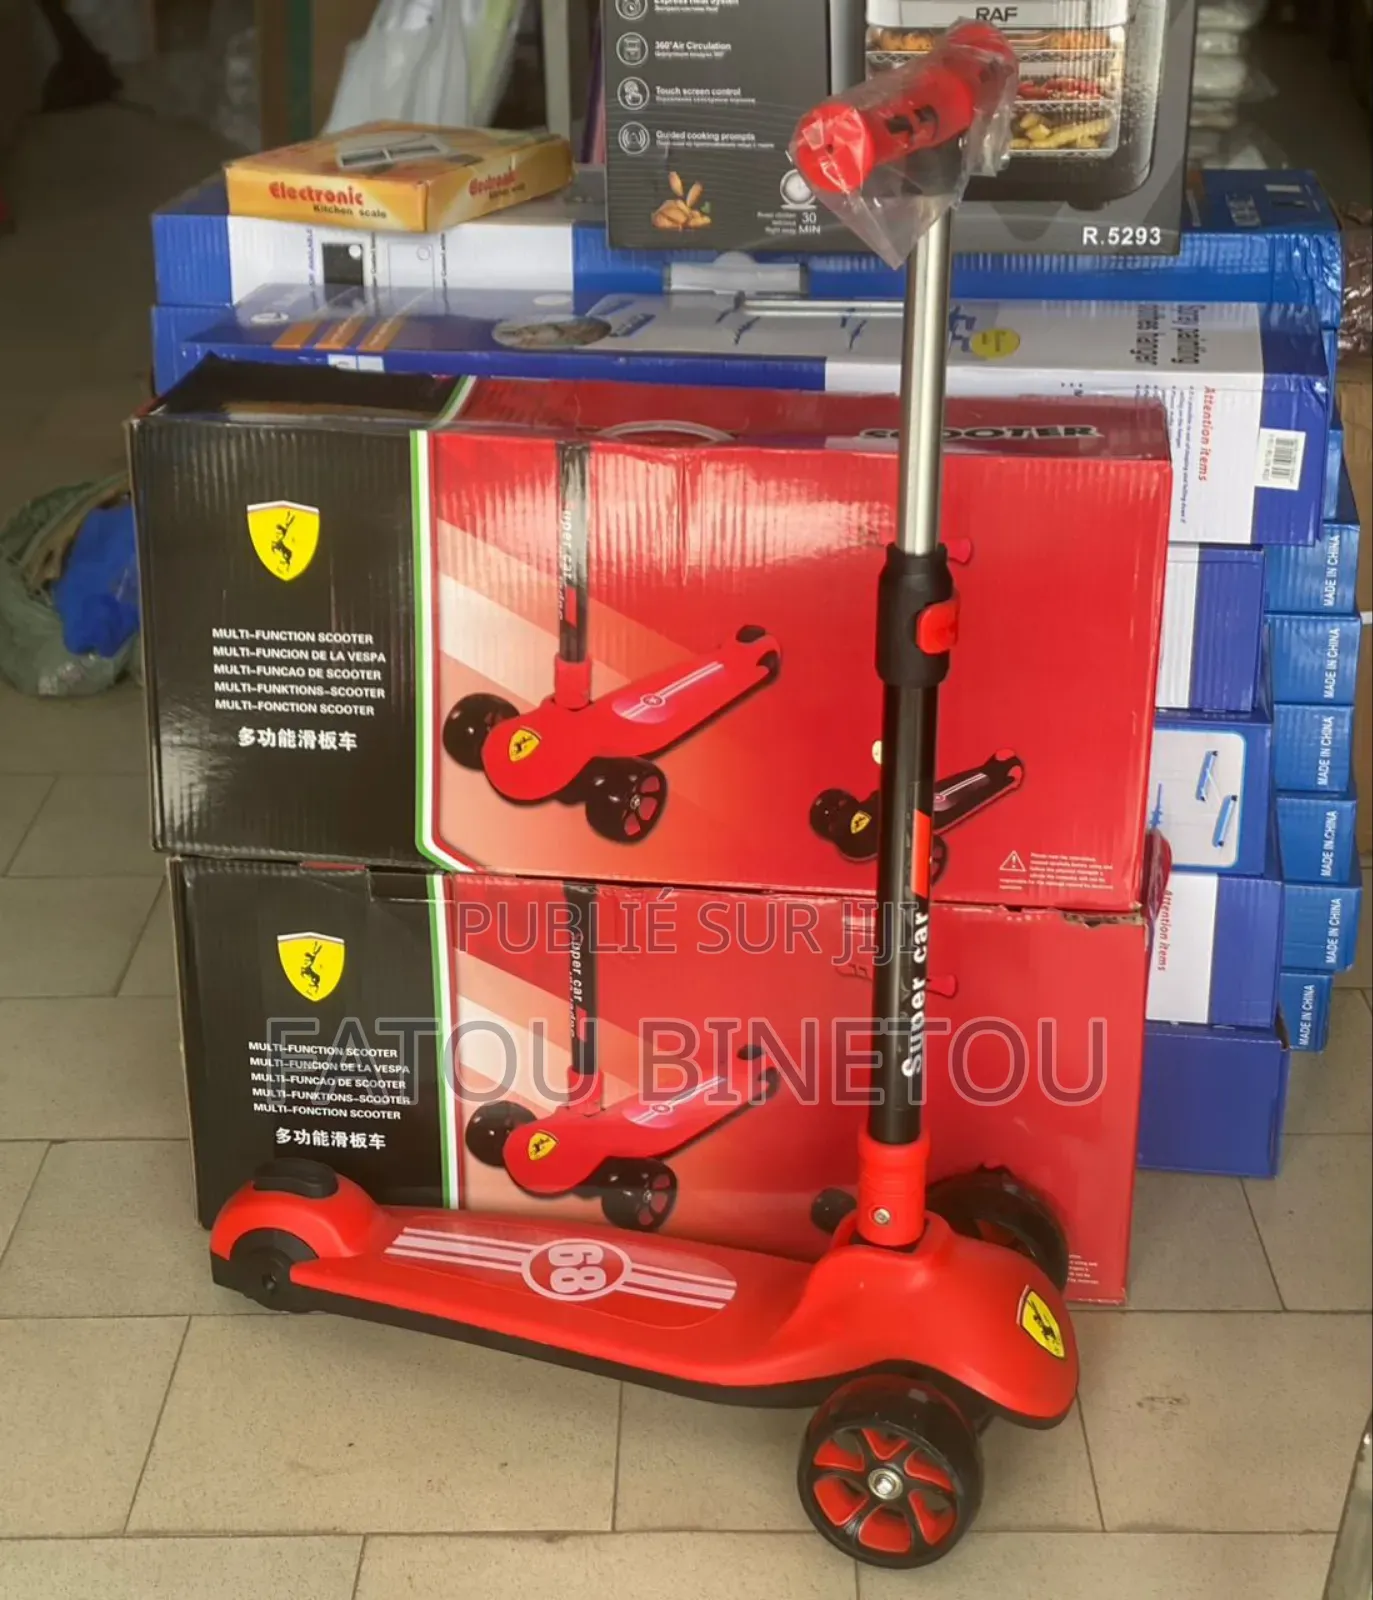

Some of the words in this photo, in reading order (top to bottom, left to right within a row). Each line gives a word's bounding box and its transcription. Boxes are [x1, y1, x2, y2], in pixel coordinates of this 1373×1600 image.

[975, 6, 1018, 22] RAF
[686, 41, 731, 51] Circulation
[656, 86, 681, 96] Touch
[683, 88, 709, 96] screen
[712, 87, 741, 96] control
[656, 130, 686, 140] Guided
[687, 132, 719, 142] cooking
[721, 132, 755, 143] prompts
[269, 181, 364, 206] Electronic
[313, 204, 354, 217] Kitchen
[359, 208, 387, 219] scale
[801, 212, 817, 224] 30
[799, 224, 821, 234] MIN
[1082, 226, 1161, 246] R.5293
[1200, 385, 1216, 446] Attention
[1198, 447, 1213, 481] items
[1327, 534, 1340, 565] CHINA
[1326, 567, 1337, 578] IN
[1323, 579, 1336, 607] MADE
[212, 628, 316, 642] MULTI-FUNCTION
[318, 632, 374, 644] SCOOTER
[1327, 627, 1340, 658] CHINA
[213, 646, 309, 660] MULTI-FUNCION
[311, 649, 328, 661] DE
[330, 650, 346, 662] LA
[346, 652, 386, 663] VESPA
[213, 663, 306, 678] MULTI-FUNCAO
[308, 667, 325, 679] DE
[326, 668, 382, 681] SCOOTER
[1326, 659, 1337, 670] IN
[214, 681, 386, 699] MULTI-FUNKTIONS-SCOOTER
[1323, 670, 1336, 698] MADE
[215, 698, 317, 713] MULTI-FONCTION
[319, 703, 375, 716] SCOOTER
[238, 725, 358, 751] 多功能滑板车
[1320, 715, 1335, 746] CHINA
[1320, 747, 1331, 757] IN
[1317, 759, 1330, 786] MADE
[1324, 810, 1339, 840] CHINA
[1323, 839, 1334, 850] IN
[1320, 850, 1334, 876] MADE
[1328, 898, 1342, 926] CHINA
[1328, 927, 1339, 937] IN
[1157, 942, 1171, 972] items
[1325, 938, 1339, 964] MADE
[573, 979, 583, 1003] car
[901, 977, 925, 1077] Super
[913, 912, 929, 964] car
[1301, 984, 1315, 1010] CHINA
[1300, 1010, 1312, 1020] IN
[1299, 1020, 1311, 1045] MADE
[248, 1041, 343, 1057] MULTI-FUNCTION
[345, 1047, 398, 1058] SCOOTER
[249, 1057, 338, 1071] MULTI-FUNCION
[340, 1062, 356, 1073] DE
[358, 1063, 372, 1073] LA
[373, 1064, 411, 1075] VESPA
[250, 1072, 336, 1086] MULTI-FUNCAO
[338, 1077, 353, 1088] DE
[354, 1078, 407, 1090] SCOOTER
[252, 1087, 411, 1105] MULTI-FUNKTIONS-SCOOTER
[253, 1103, 348, 1118] MULTI-FONCTION
[349, 1109, 401, 1120] SCOOTER
[275, 1127, 387, 1150] 多功能滑板车
[549, 1244, 606, 1293] 68
